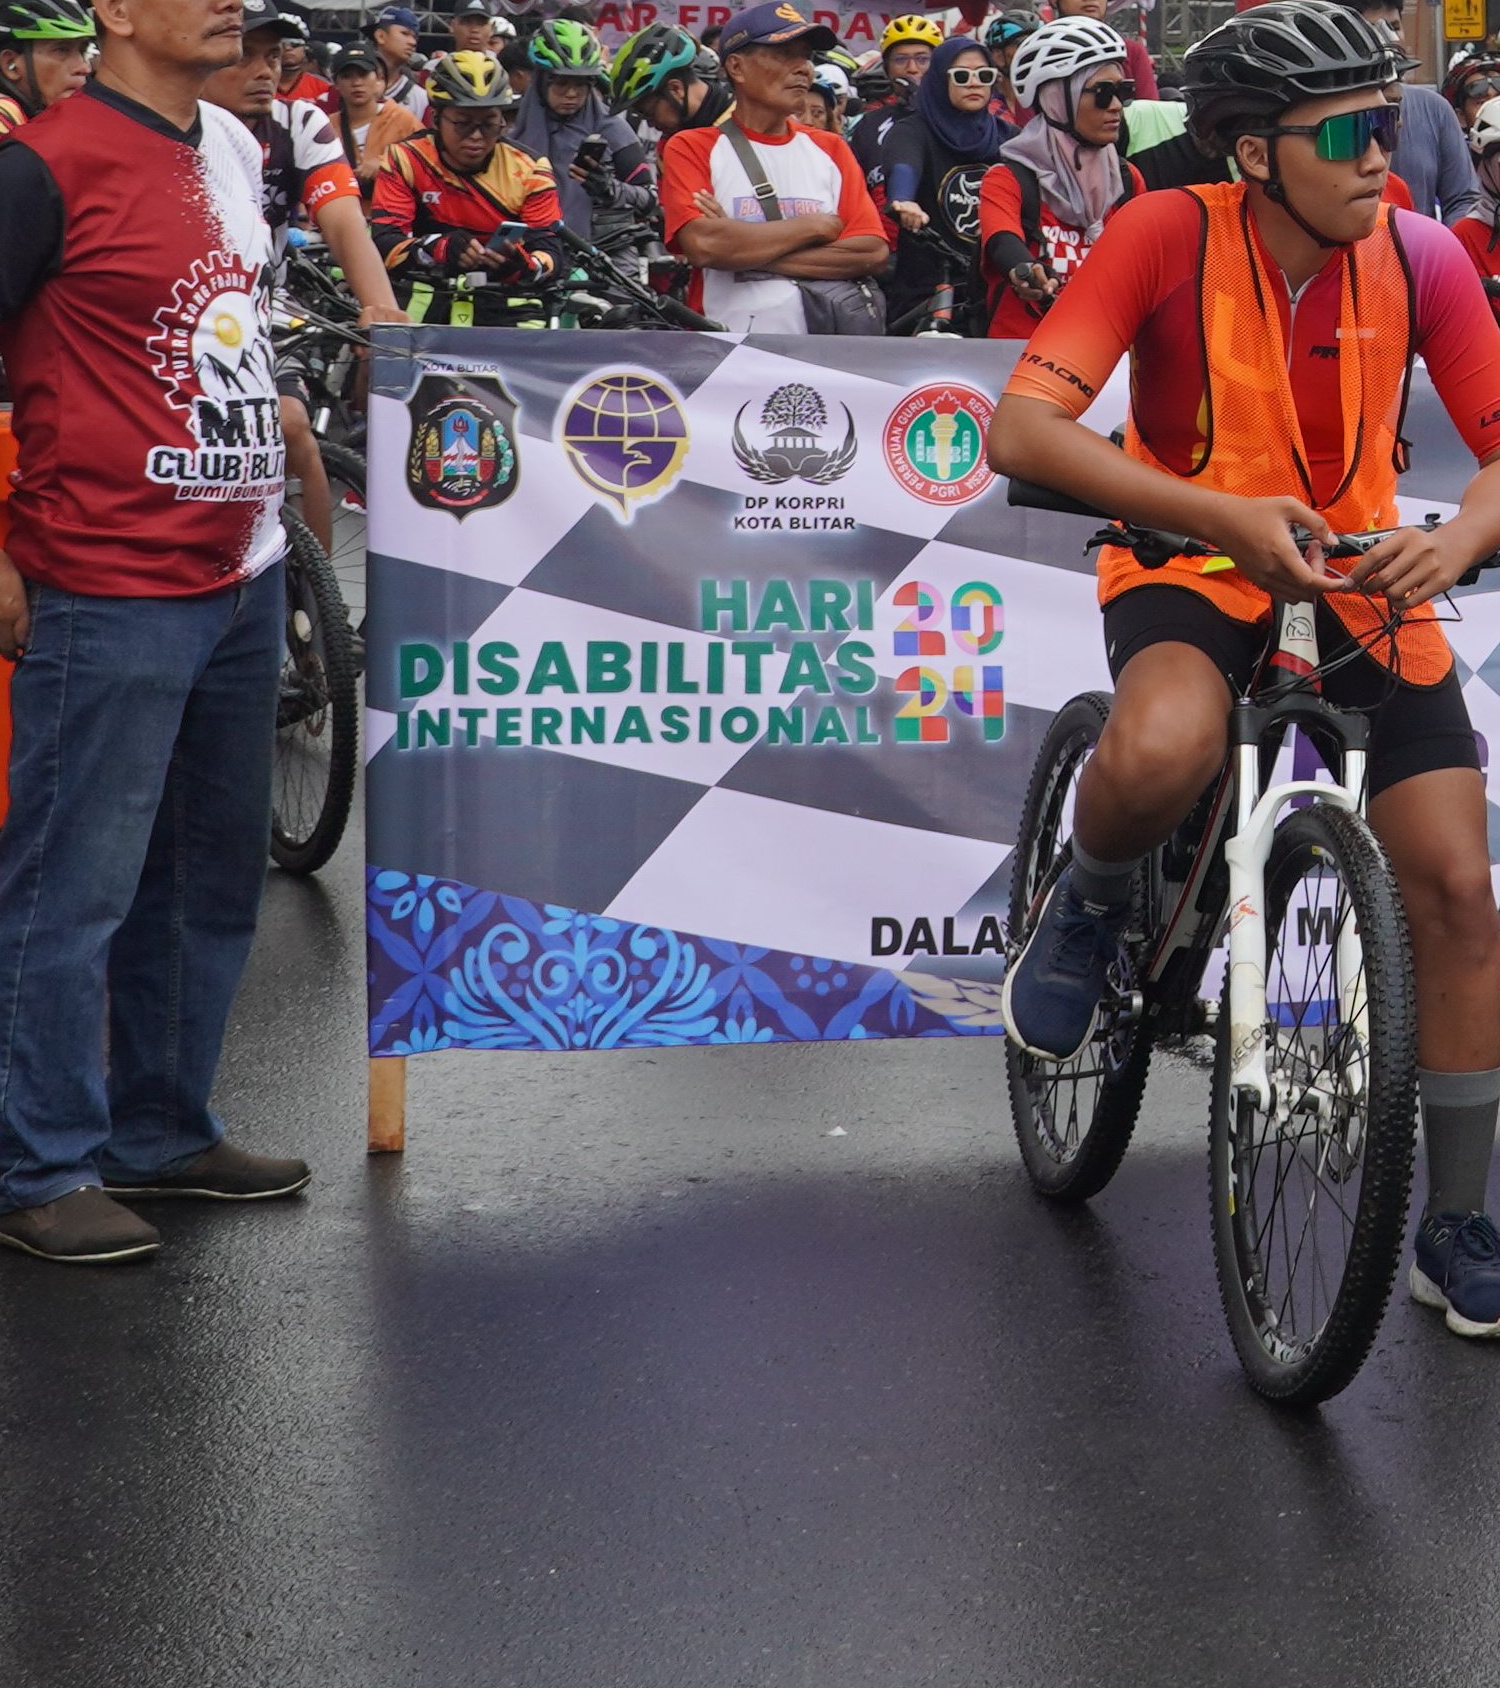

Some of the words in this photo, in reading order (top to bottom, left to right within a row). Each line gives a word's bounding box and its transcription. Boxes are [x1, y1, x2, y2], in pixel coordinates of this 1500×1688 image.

[595, 2, 658, 33] AR
[422, 361, 453, 374] KOTA
[455, 362, 499, 375] BLITAR
[1030, 354, 1095, 399] RACING
[897, 397, 927, 425] GURU
[153, 450, 244, 483] CLUB
[745, 495, 774, 511] DP
[777, 495, 845, 511] KORPRI
[928, 484, 962, 498] PGRI
[734, 516, 785, 531] KOTA
[788, 516, 856, 531] BLITAR
[702, 579, 876, 632] HARI
[399, 641, 879, 700] DISABILITAS
[397, 706, 882, 751] INTERNASIONAL
[869, 915, 1005, 958] DALA
